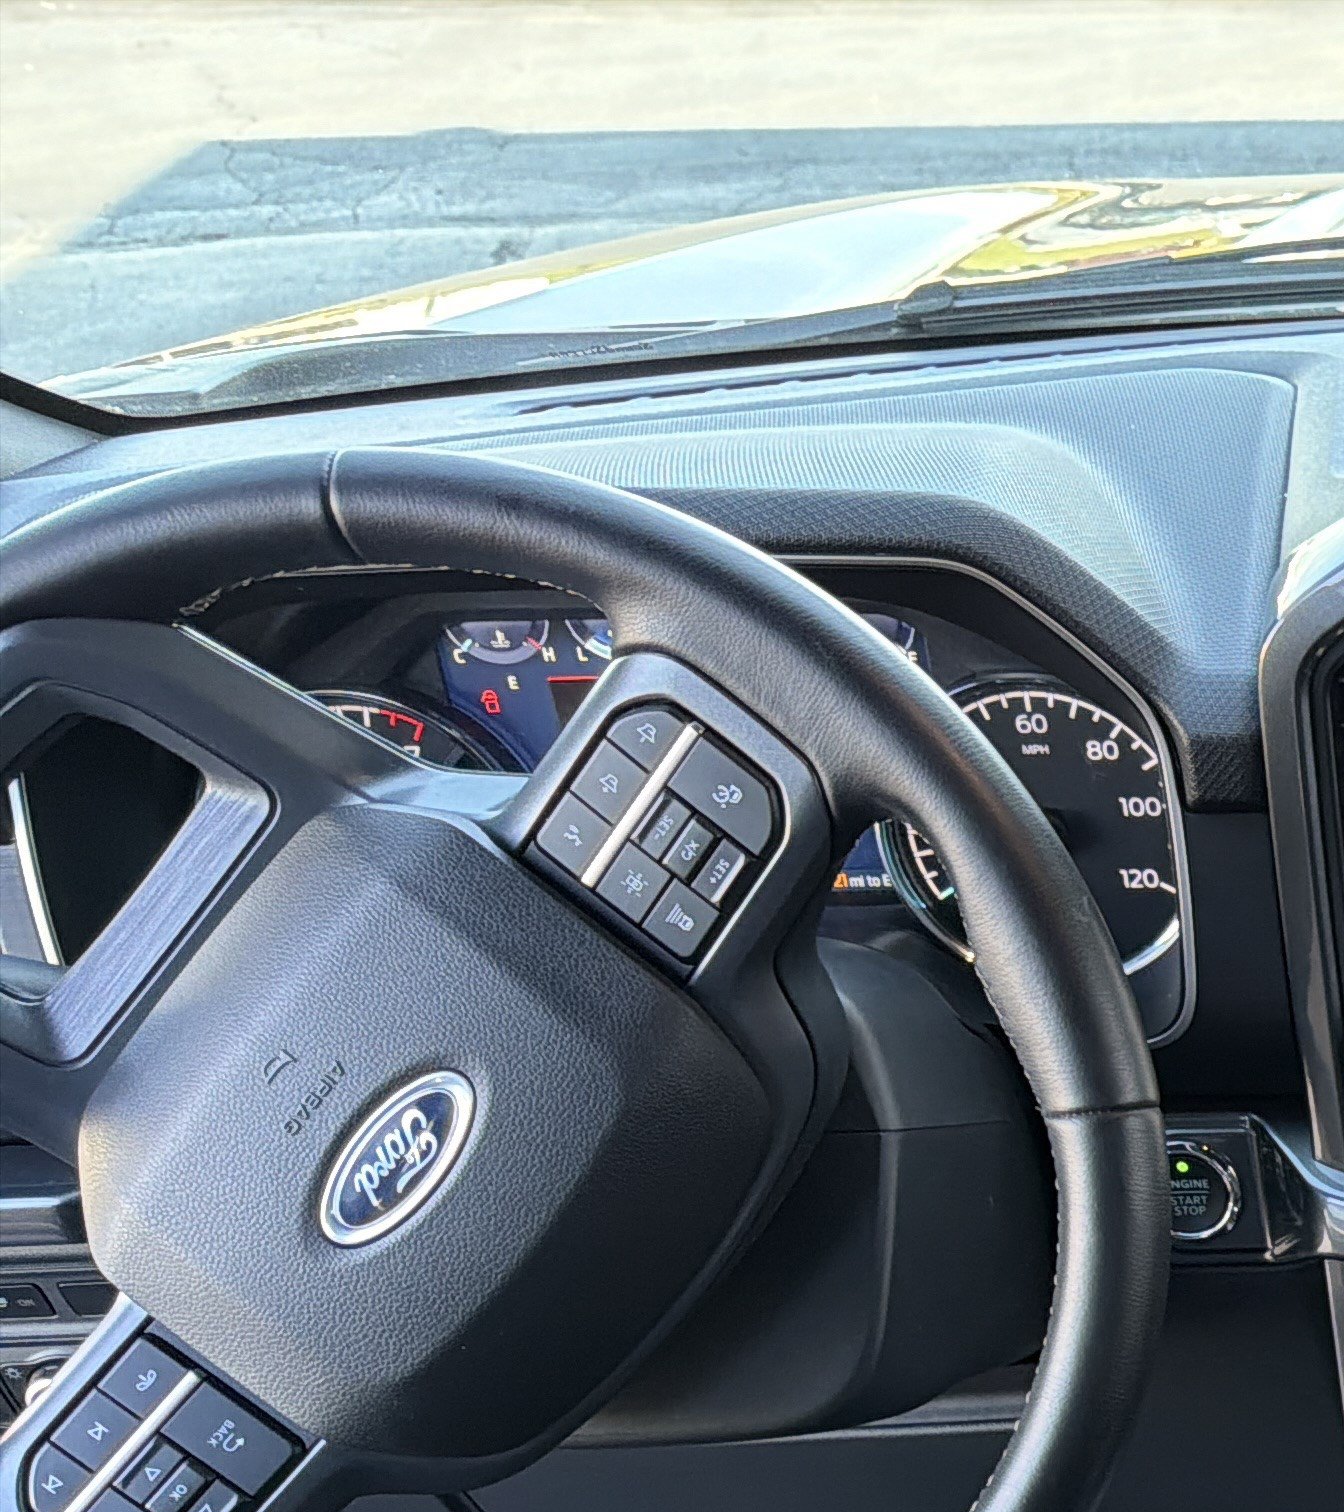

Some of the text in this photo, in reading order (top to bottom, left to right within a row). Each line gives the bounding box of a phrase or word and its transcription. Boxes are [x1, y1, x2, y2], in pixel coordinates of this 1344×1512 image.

[542, 647, 557, 662] H
[576, 646, 588, 662] L
[1015, 714, 1048, 735] 60
[1022, 745, 1050, 756] MPH
[1086, 741, 1120, 761] 80
[1118, 797, 1162, 816] 100
[1118, 869, 1160, 889] 120
[284, 1060, 346, 1136] AIRBAG
[354, 1108, 437, 1208] Ford
[1170, 1179, 1210, 1189] NGINE
[1170, 1195, 1209, 1206] START
[1174, 1206, 1207, 1216] STOP
[207, 1419, 235, 1447] BACK
[169, 1484, 188, 1502] OK
